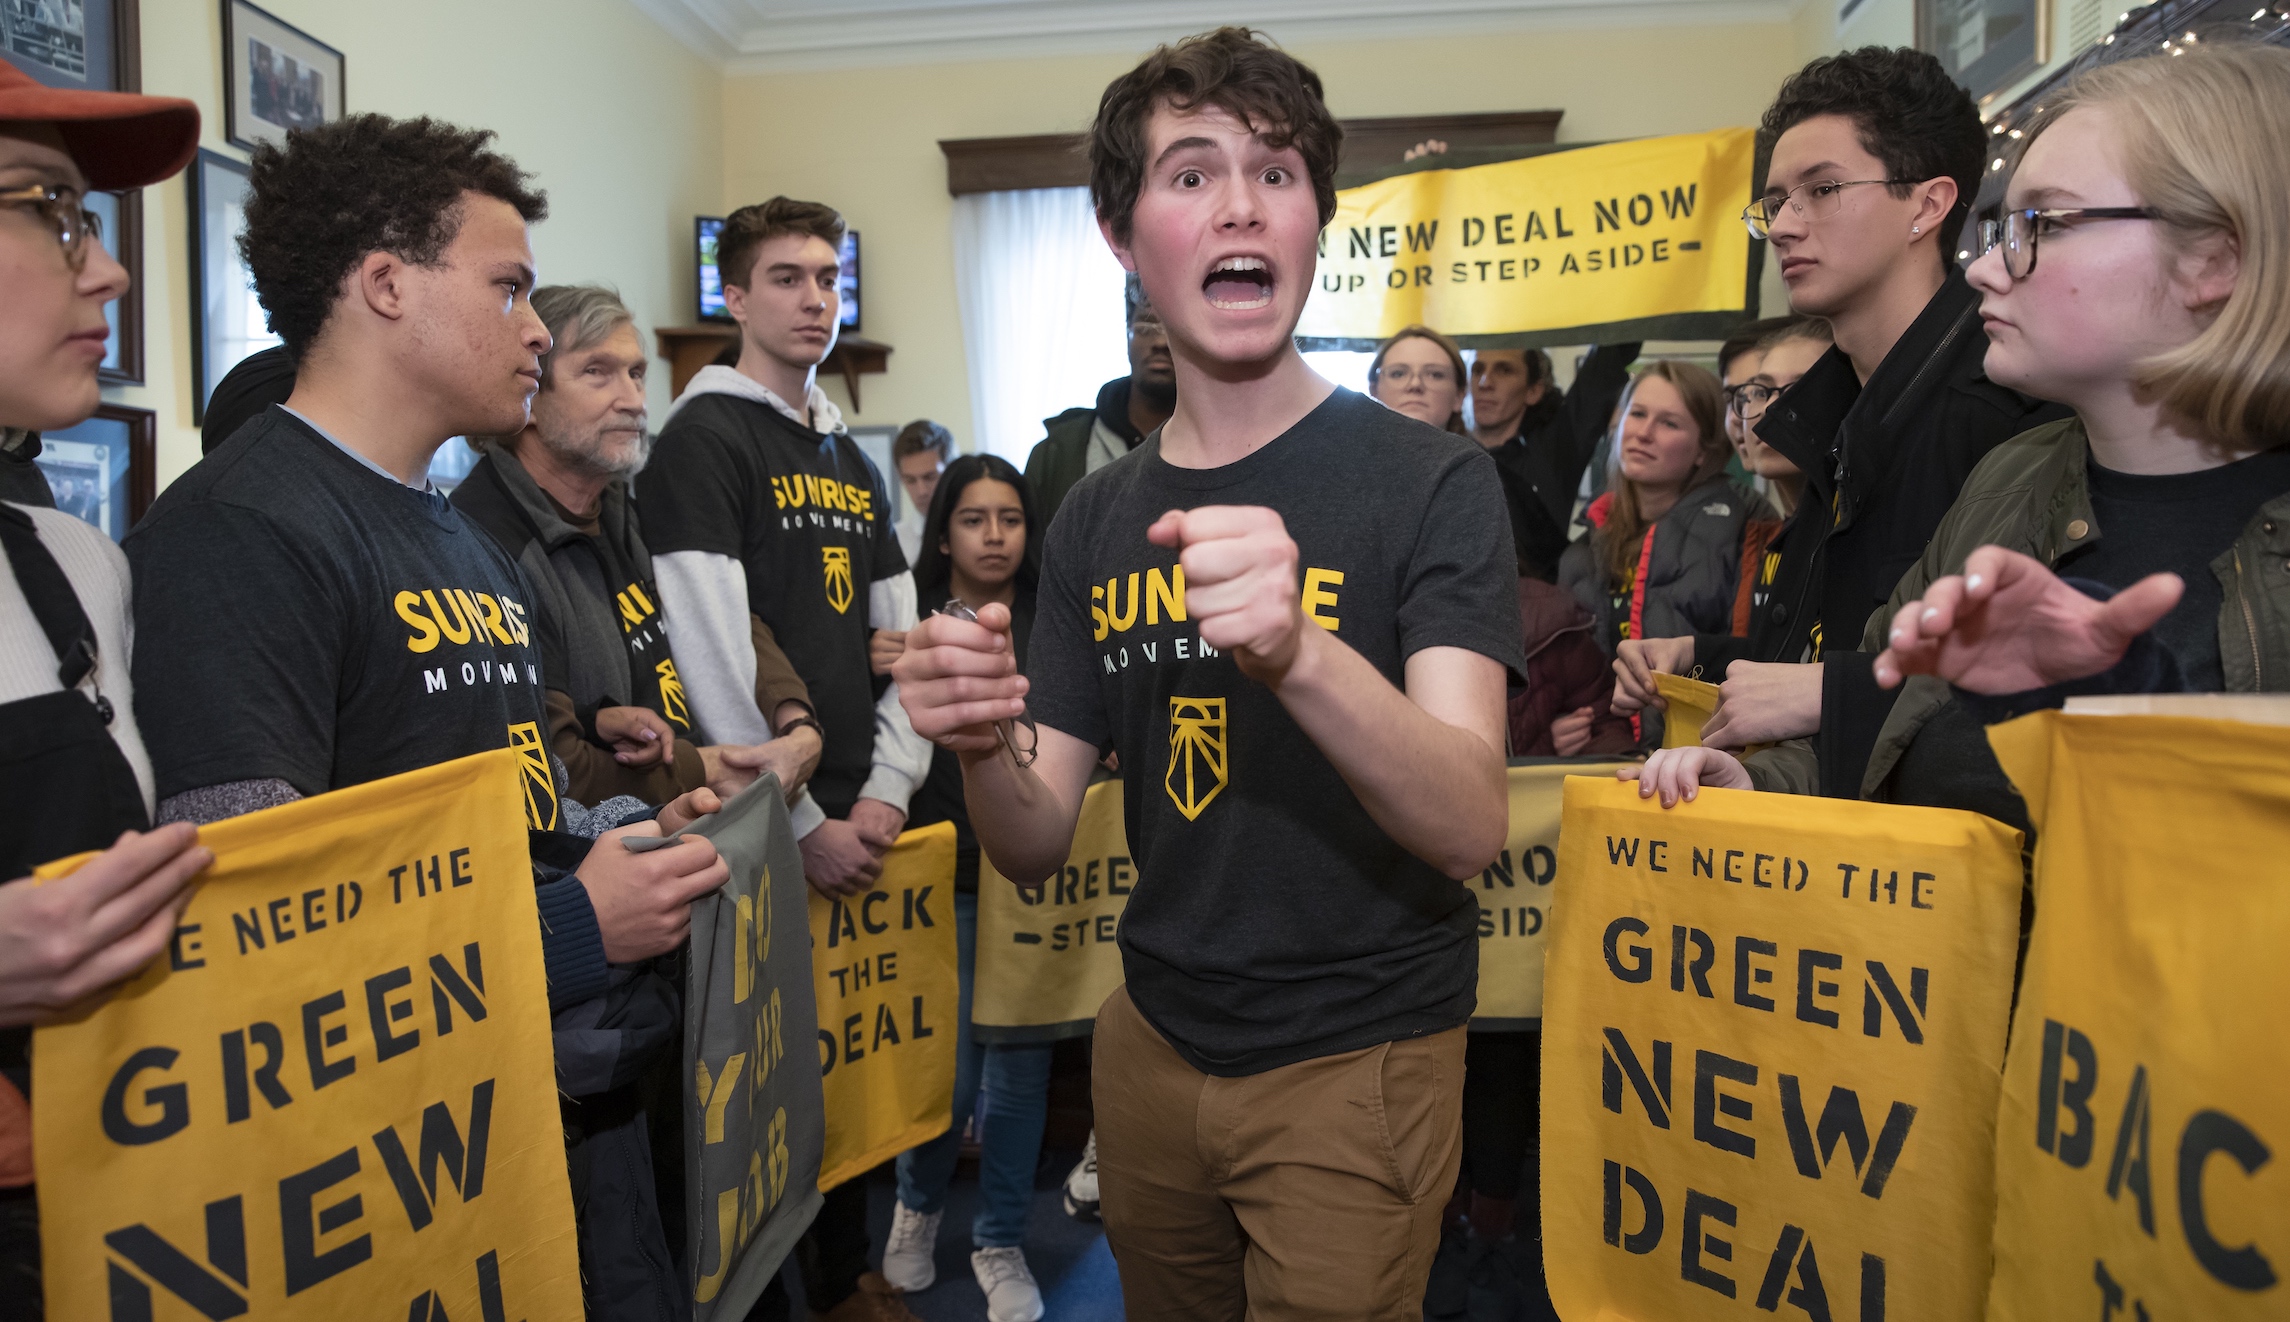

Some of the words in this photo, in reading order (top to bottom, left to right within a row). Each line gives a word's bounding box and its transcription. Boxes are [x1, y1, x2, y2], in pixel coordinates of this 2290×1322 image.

[1350, 219, 1438, 260] NEW
[1463, 206, 1574, 248] DEAL
[1594, 183, 1697, 233] NOW
[1322, 273, 1365, 294] UP
[1387, 265, 1433, 290] OR
[1451, 257, 1541, 283] STEP
[394, 588, 530, 654] SUNRIS
[1091, 564, 1345, 643] SUNE
[1103, 637, 1219, 677] MOVEM
[171, 922, 206, 973] E
[232, 880, 363, 956] NEED
[388, 847, 473, 904] THE
[1016, 857, 1131, 907] GREE
[1482, 845, 1557, 889] NO
[1605, 835, 1668, 873] WE
[1692, 846, 1810, 893] NEED
[1837, 863, 1936, 910] THE
[813, 885, 935, 949] ACK
[1477, 906, 1543, 938] SID
[829, 952, 898, 999] THE
[1602, 915, 1930, 1046] GREEN
[101, 940, 488, 1147] GREEN
[818, 995, 934, 1078] DEAL
[1602, 1026, 1919, 1200] NEW
[2036, 1017, 2280, 1293] BAC
[103, 1076, 496, 1322] NEW
[694, 1106, 790, 1304] JOB
